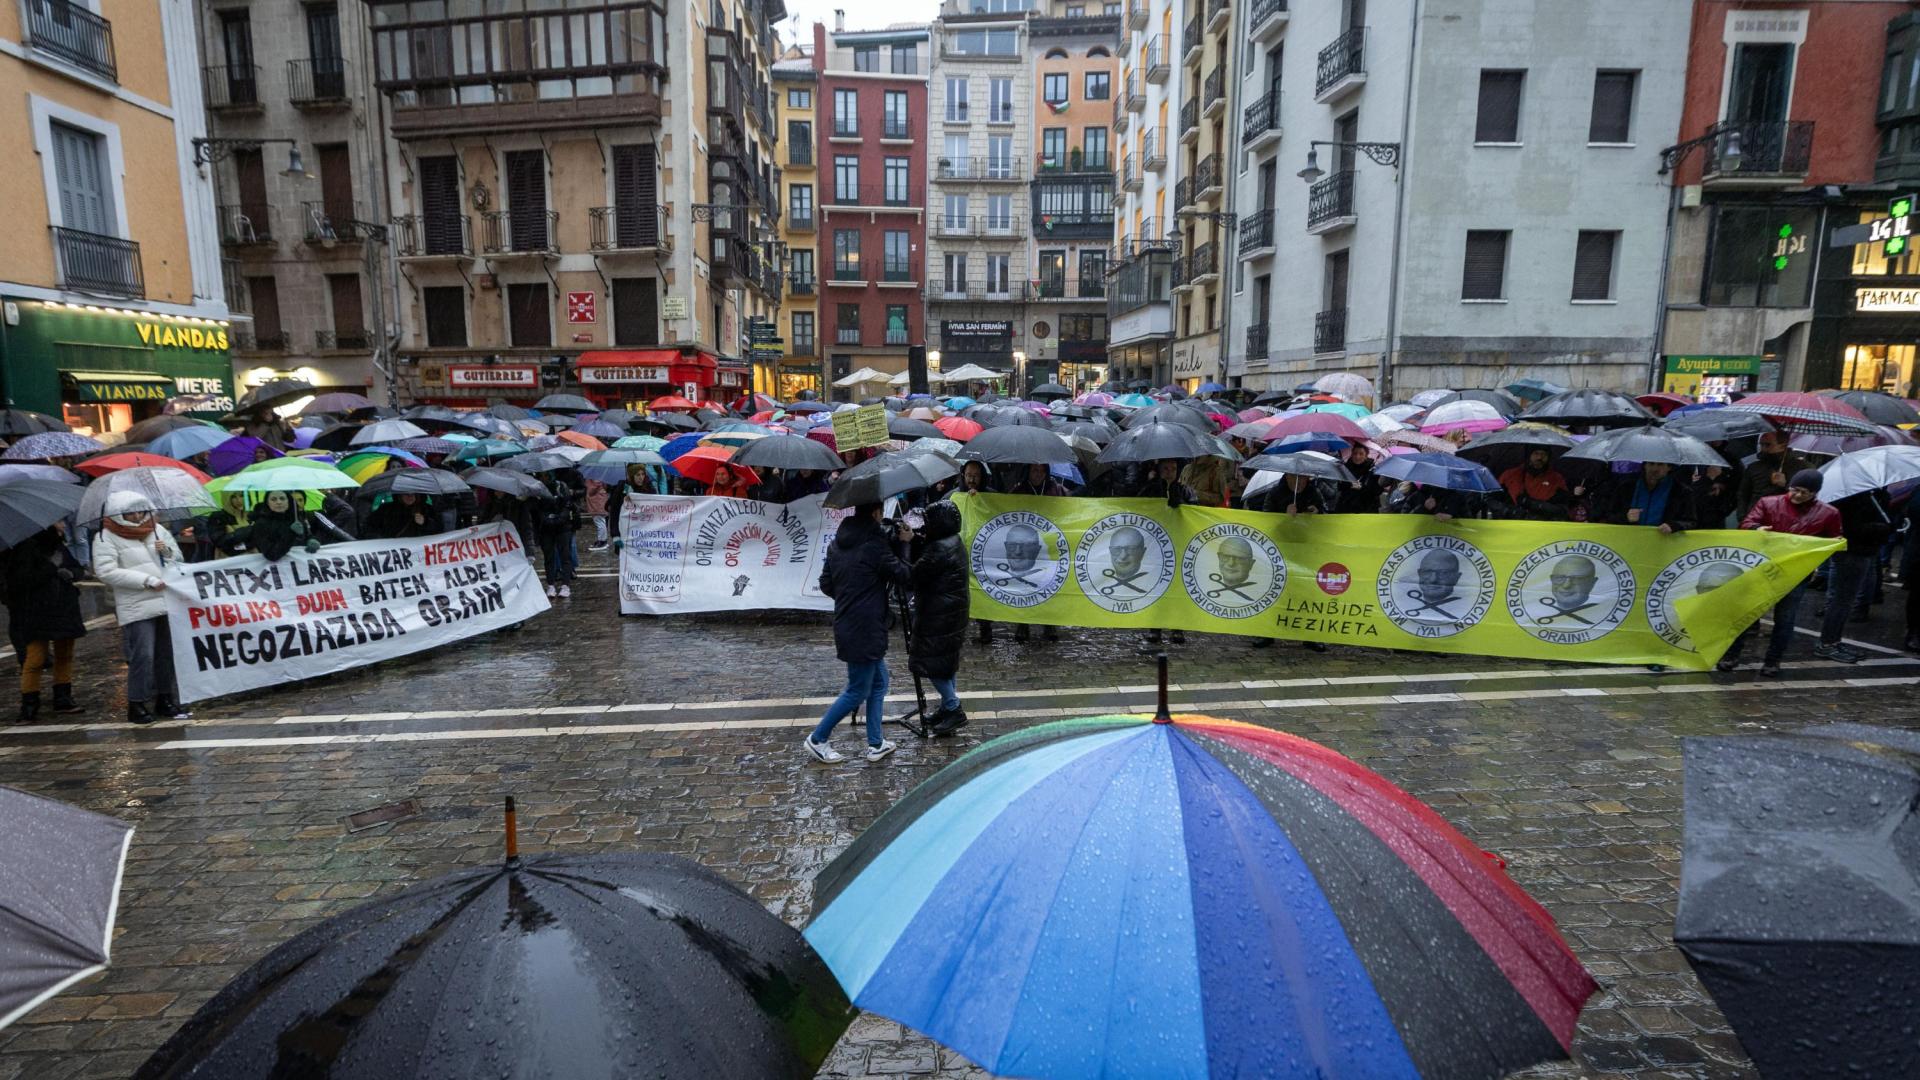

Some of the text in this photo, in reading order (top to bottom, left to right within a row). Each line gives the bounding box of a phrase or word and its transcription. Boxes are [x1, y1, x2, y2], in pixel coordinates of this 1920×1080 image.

[135, 322, 229, 350] VIANDAS
[174, 377, 223, 394] WE'RE
[463, 371, 524, 381] GUTIERREZ
[592, 368, 657, 380] GUTIERREZ
[91, 384, 167, 399] VIANDAS
[762, 530, 778, 544] EN
[1077, 515, 1175, 584] MAS HORAS TUTORIA DUAL
[1404, 537, 1476, 558] LECTIVAS
[194, 564, 284, 600] PATXI
[290, 547, 413, 587] LARRAINZAR
[1184, 525, 1285, 612] IRAKASLE TEKNIKOEN OSAGARRIA
[1379, 552, 1404, 597] HORAS
[1508, 542, 1634, 624] ORONOZEN LANBIDE ESKOLA
[1648, 570, 1677, 619] HORAS
[1675, 548, 1763, 571] FORMACI
[188, 600, 282, 630] PUBLIKO
[296, 588, 349, 616] DUIN
[359, 573, 430, 605] BATEN
[1286, 598, 1374, 618] LANBIDE
[1382, 600, 1408, 626] MAS
[192, 582, 506, 672] NEGOZIAZIOA ORAIN
[1276, 614, 1378, 636] HEZIKETA
[1538, 629, 1591, 643] ORAIN!!
